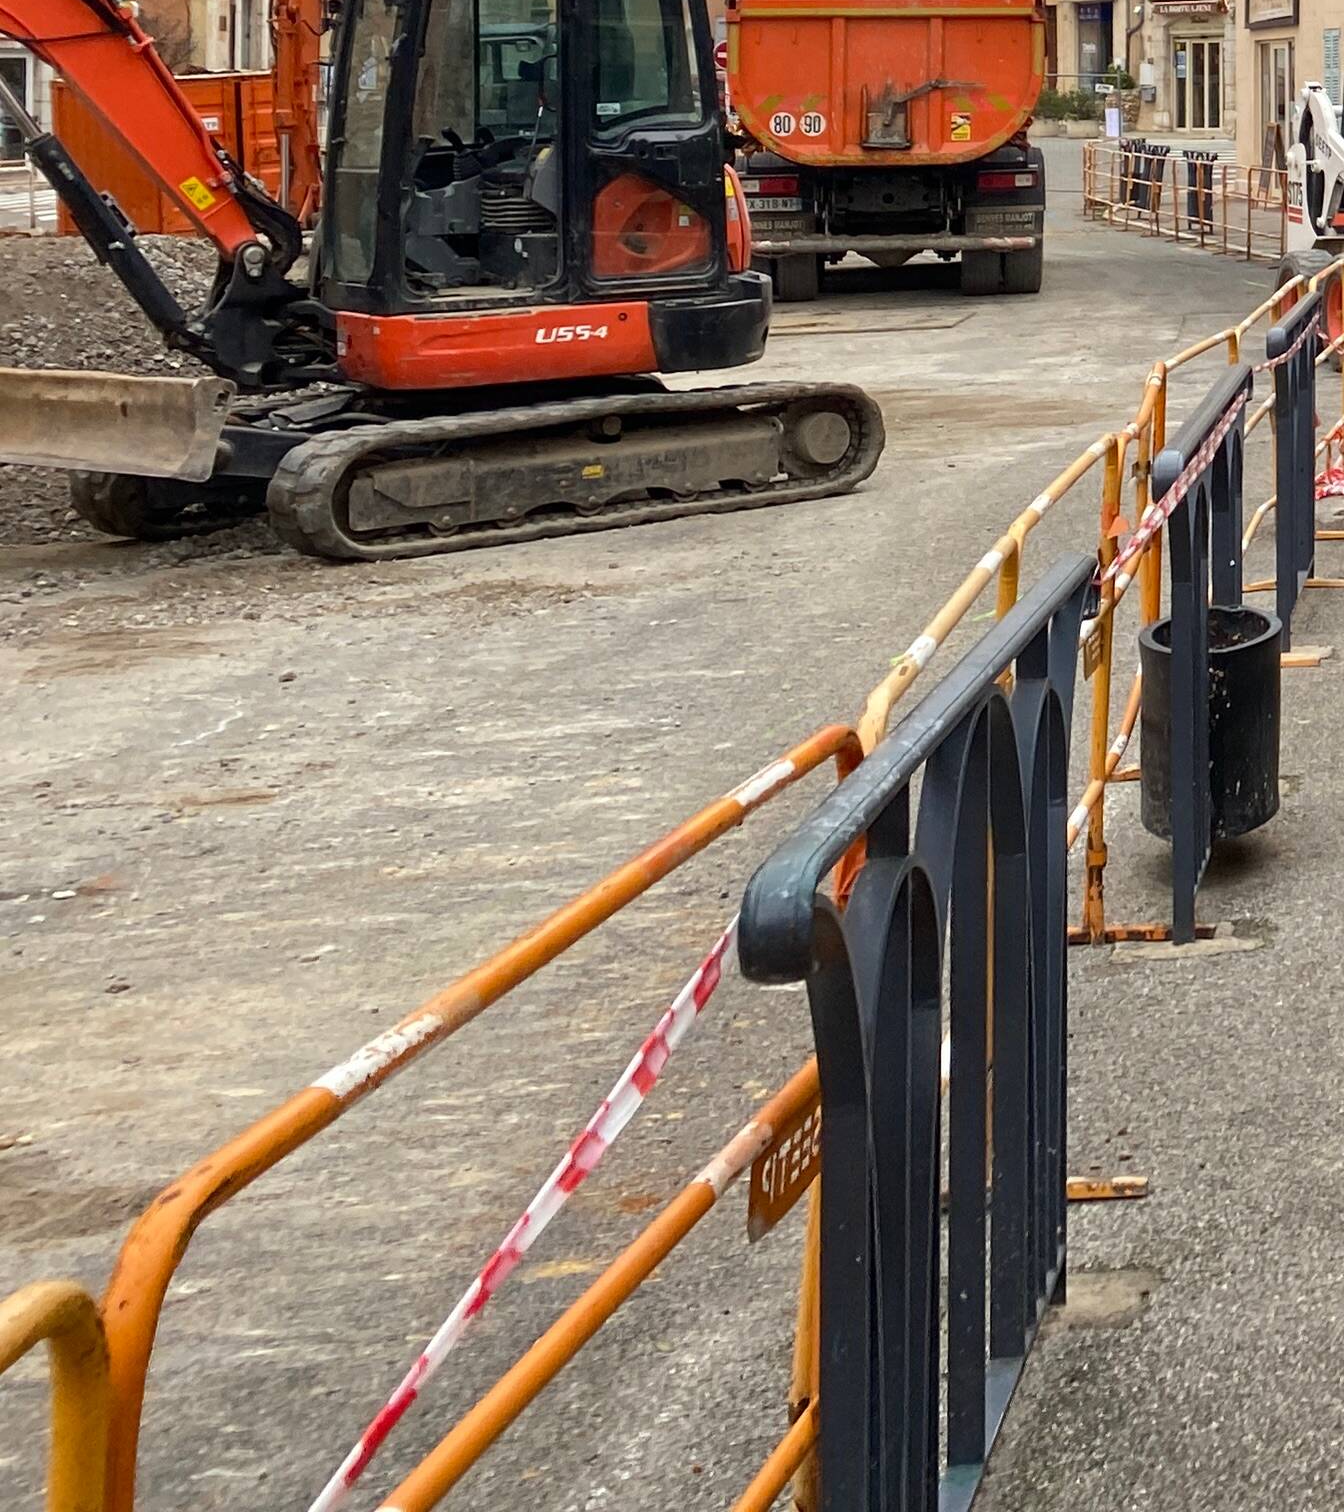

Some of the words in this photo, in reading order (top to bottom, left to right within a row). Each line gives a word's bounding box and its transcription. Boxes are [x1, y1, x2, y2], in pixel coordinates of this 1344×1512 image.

[773, 115, 791, 134] 80
[803, 115, 822, 134] 90
[535, 325, 608, 344] U55-4
